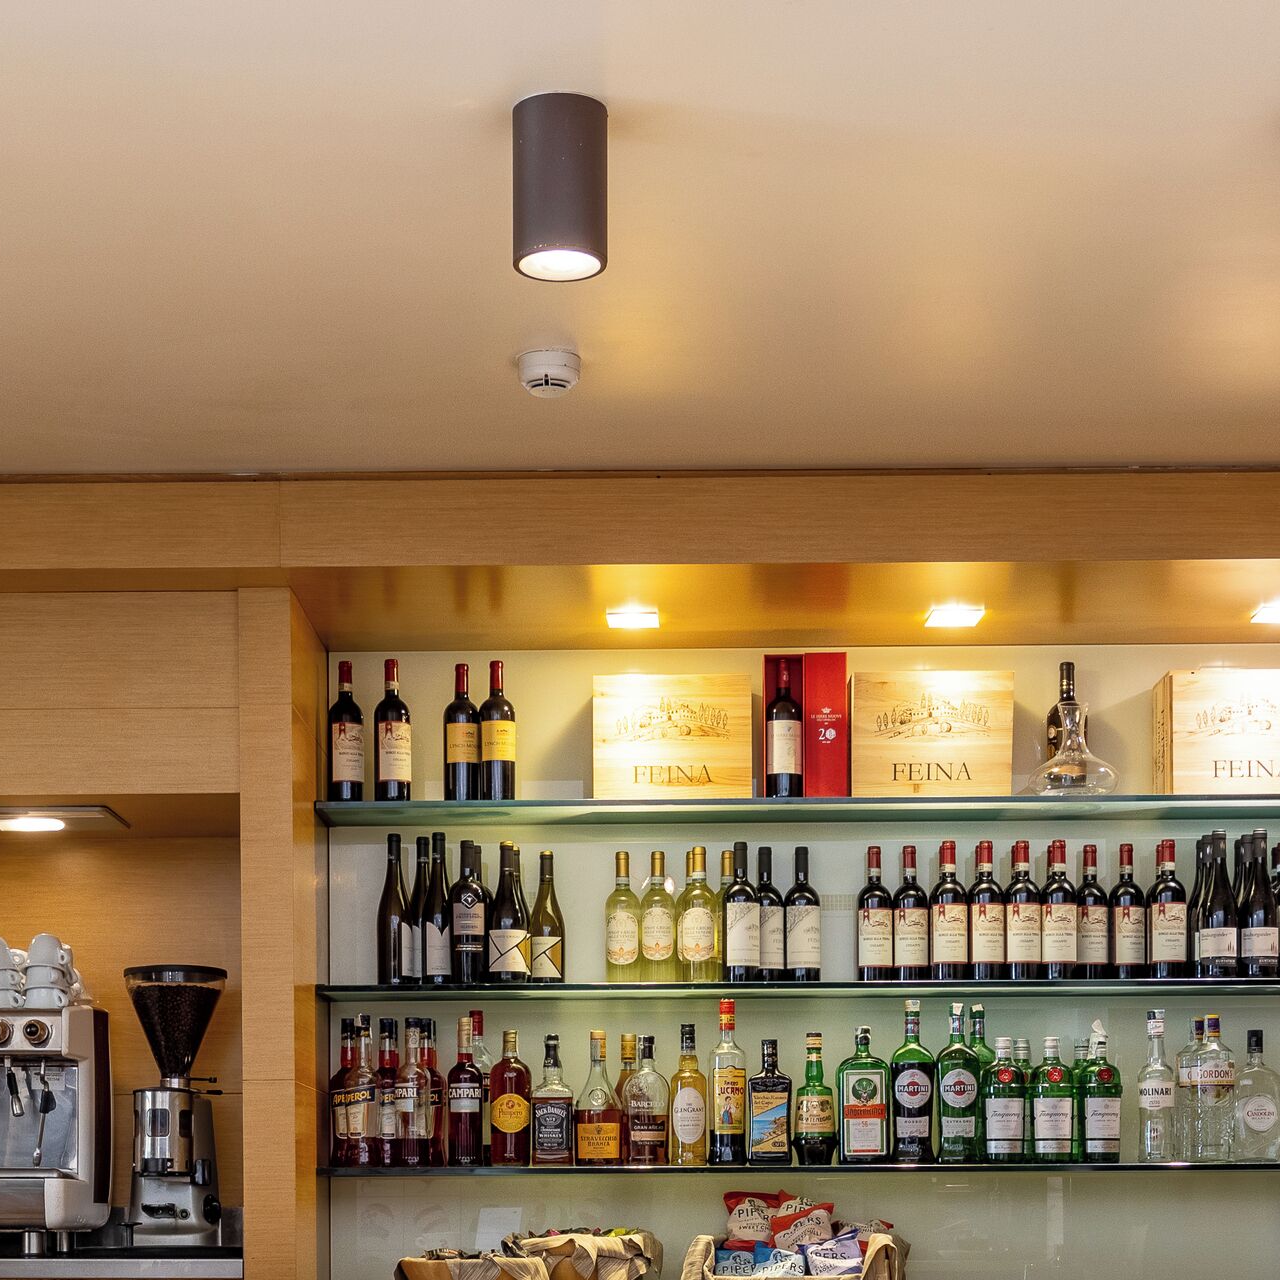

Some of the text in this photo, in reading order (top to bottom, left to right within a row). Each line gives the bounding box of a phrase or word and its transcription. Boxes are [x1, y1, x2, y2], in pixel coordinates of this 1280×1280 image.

[632, 764, 713, 784] FEINA
[892, 762, 972, 781] FEINA
[448, 1088, 481, 1098] CAMPARI
[898, 1085, 928, 1093] MARTINI
[944, 1084, 974, 1092] MARTINI
[1138, 1087, 1172, 1096] MOLINARI
[332, 1094, 345, 1105] APE
[536, 1107, 548, 1118] JACK
